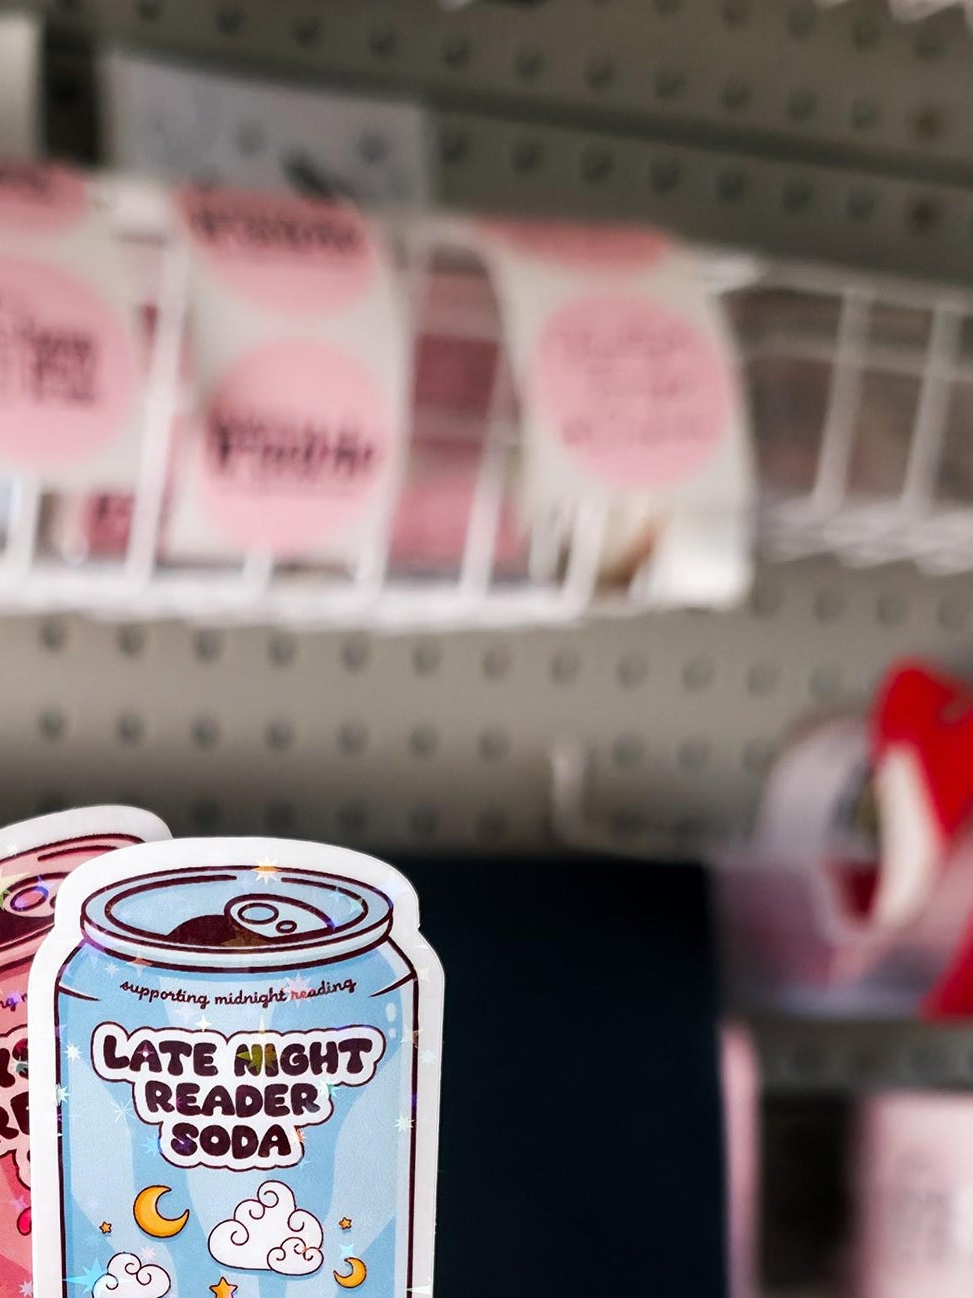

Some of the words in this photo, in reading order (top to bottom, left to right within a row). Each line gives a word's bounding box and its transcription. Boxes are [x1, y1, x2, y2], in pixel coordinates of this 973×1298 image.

[119, 980, 210, 1009] supporting
[214, 985, 287, 1009] midnight
[290, 977, 357, 999] reading
[102, 1034, 219, 1077] LATE
[233, 1037, 374, 1078] NIGHT
[144, 1081, 321, 1118] READER
[169, 1123, 292, 1160] SODA
